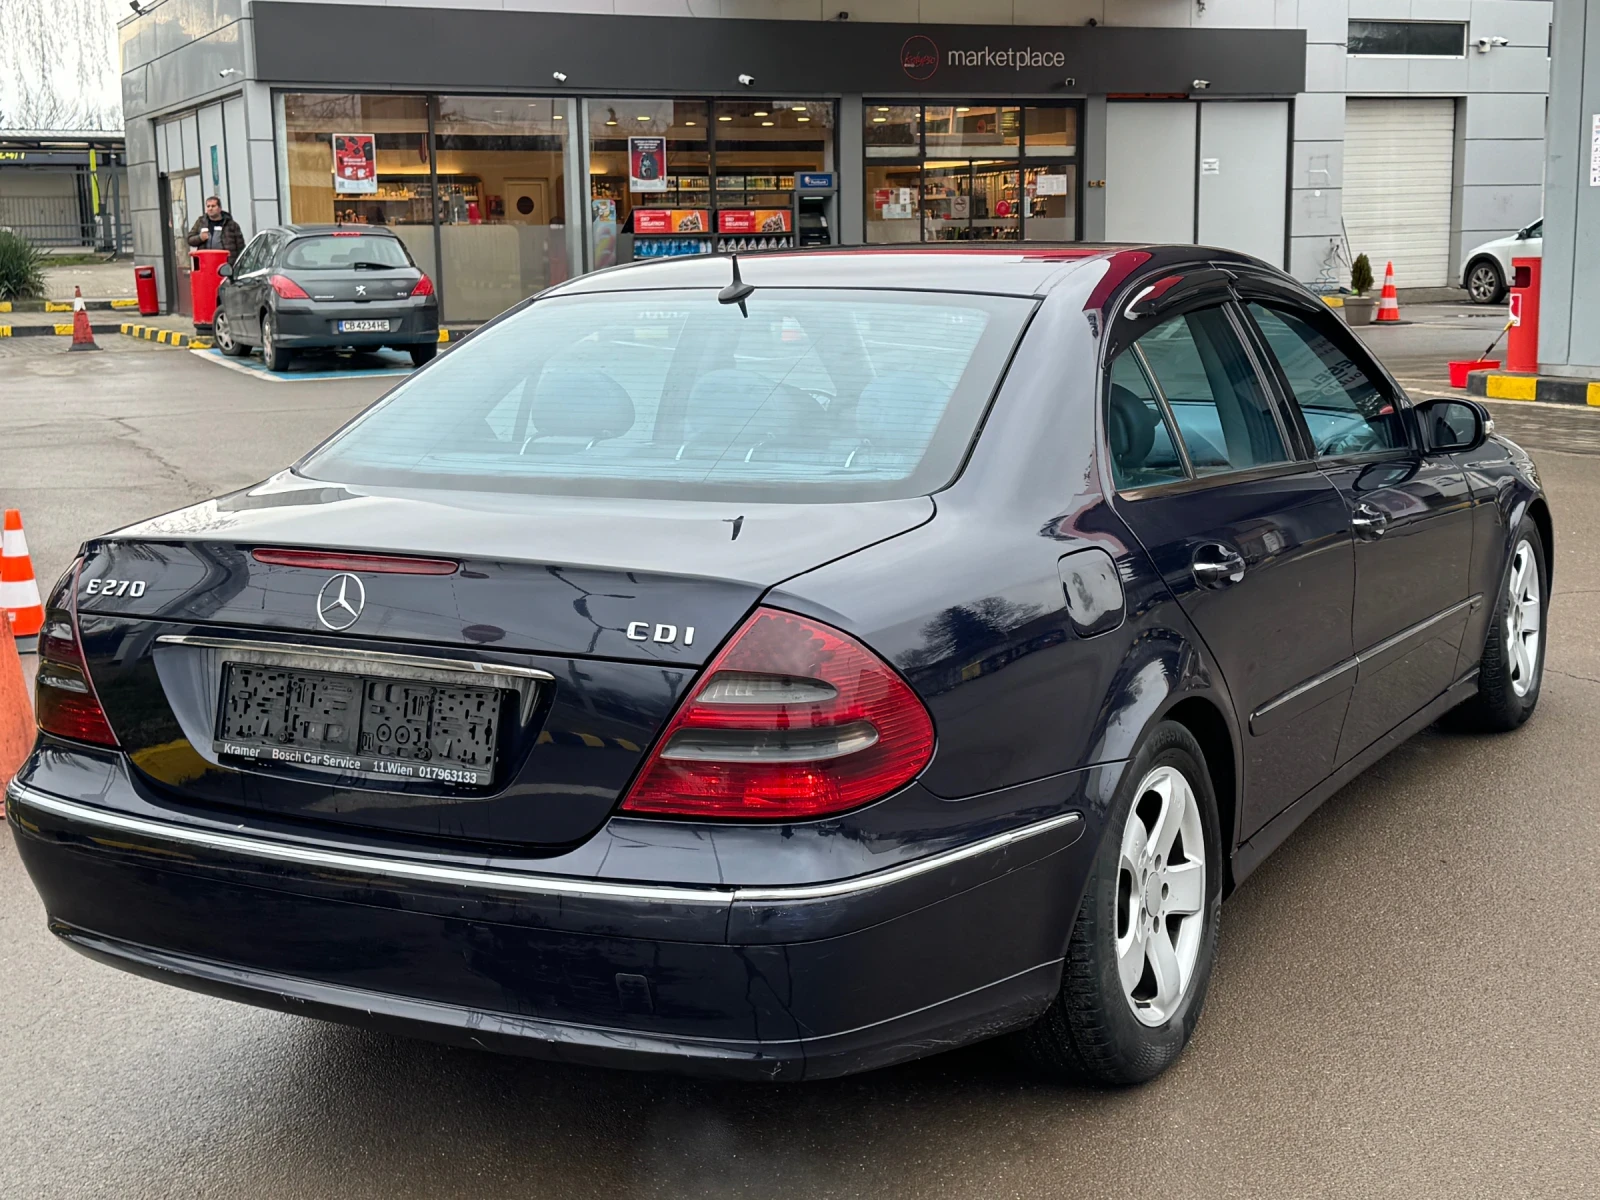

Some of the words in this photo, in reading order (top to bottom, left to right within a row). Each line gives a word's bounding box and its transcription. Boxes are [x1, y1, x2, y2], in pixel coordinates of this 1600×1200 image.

[948, 46, 1065, 71] marketplace
[626, 621, 695, 645] CDI
[223, 743, 260, 757] Kramer
[272, 748, 301, 762] Bosch
[303, 752, 321, 765] Car
[323, 754, 361, 770] Service
[419, 765, 478, 784] 017963133
